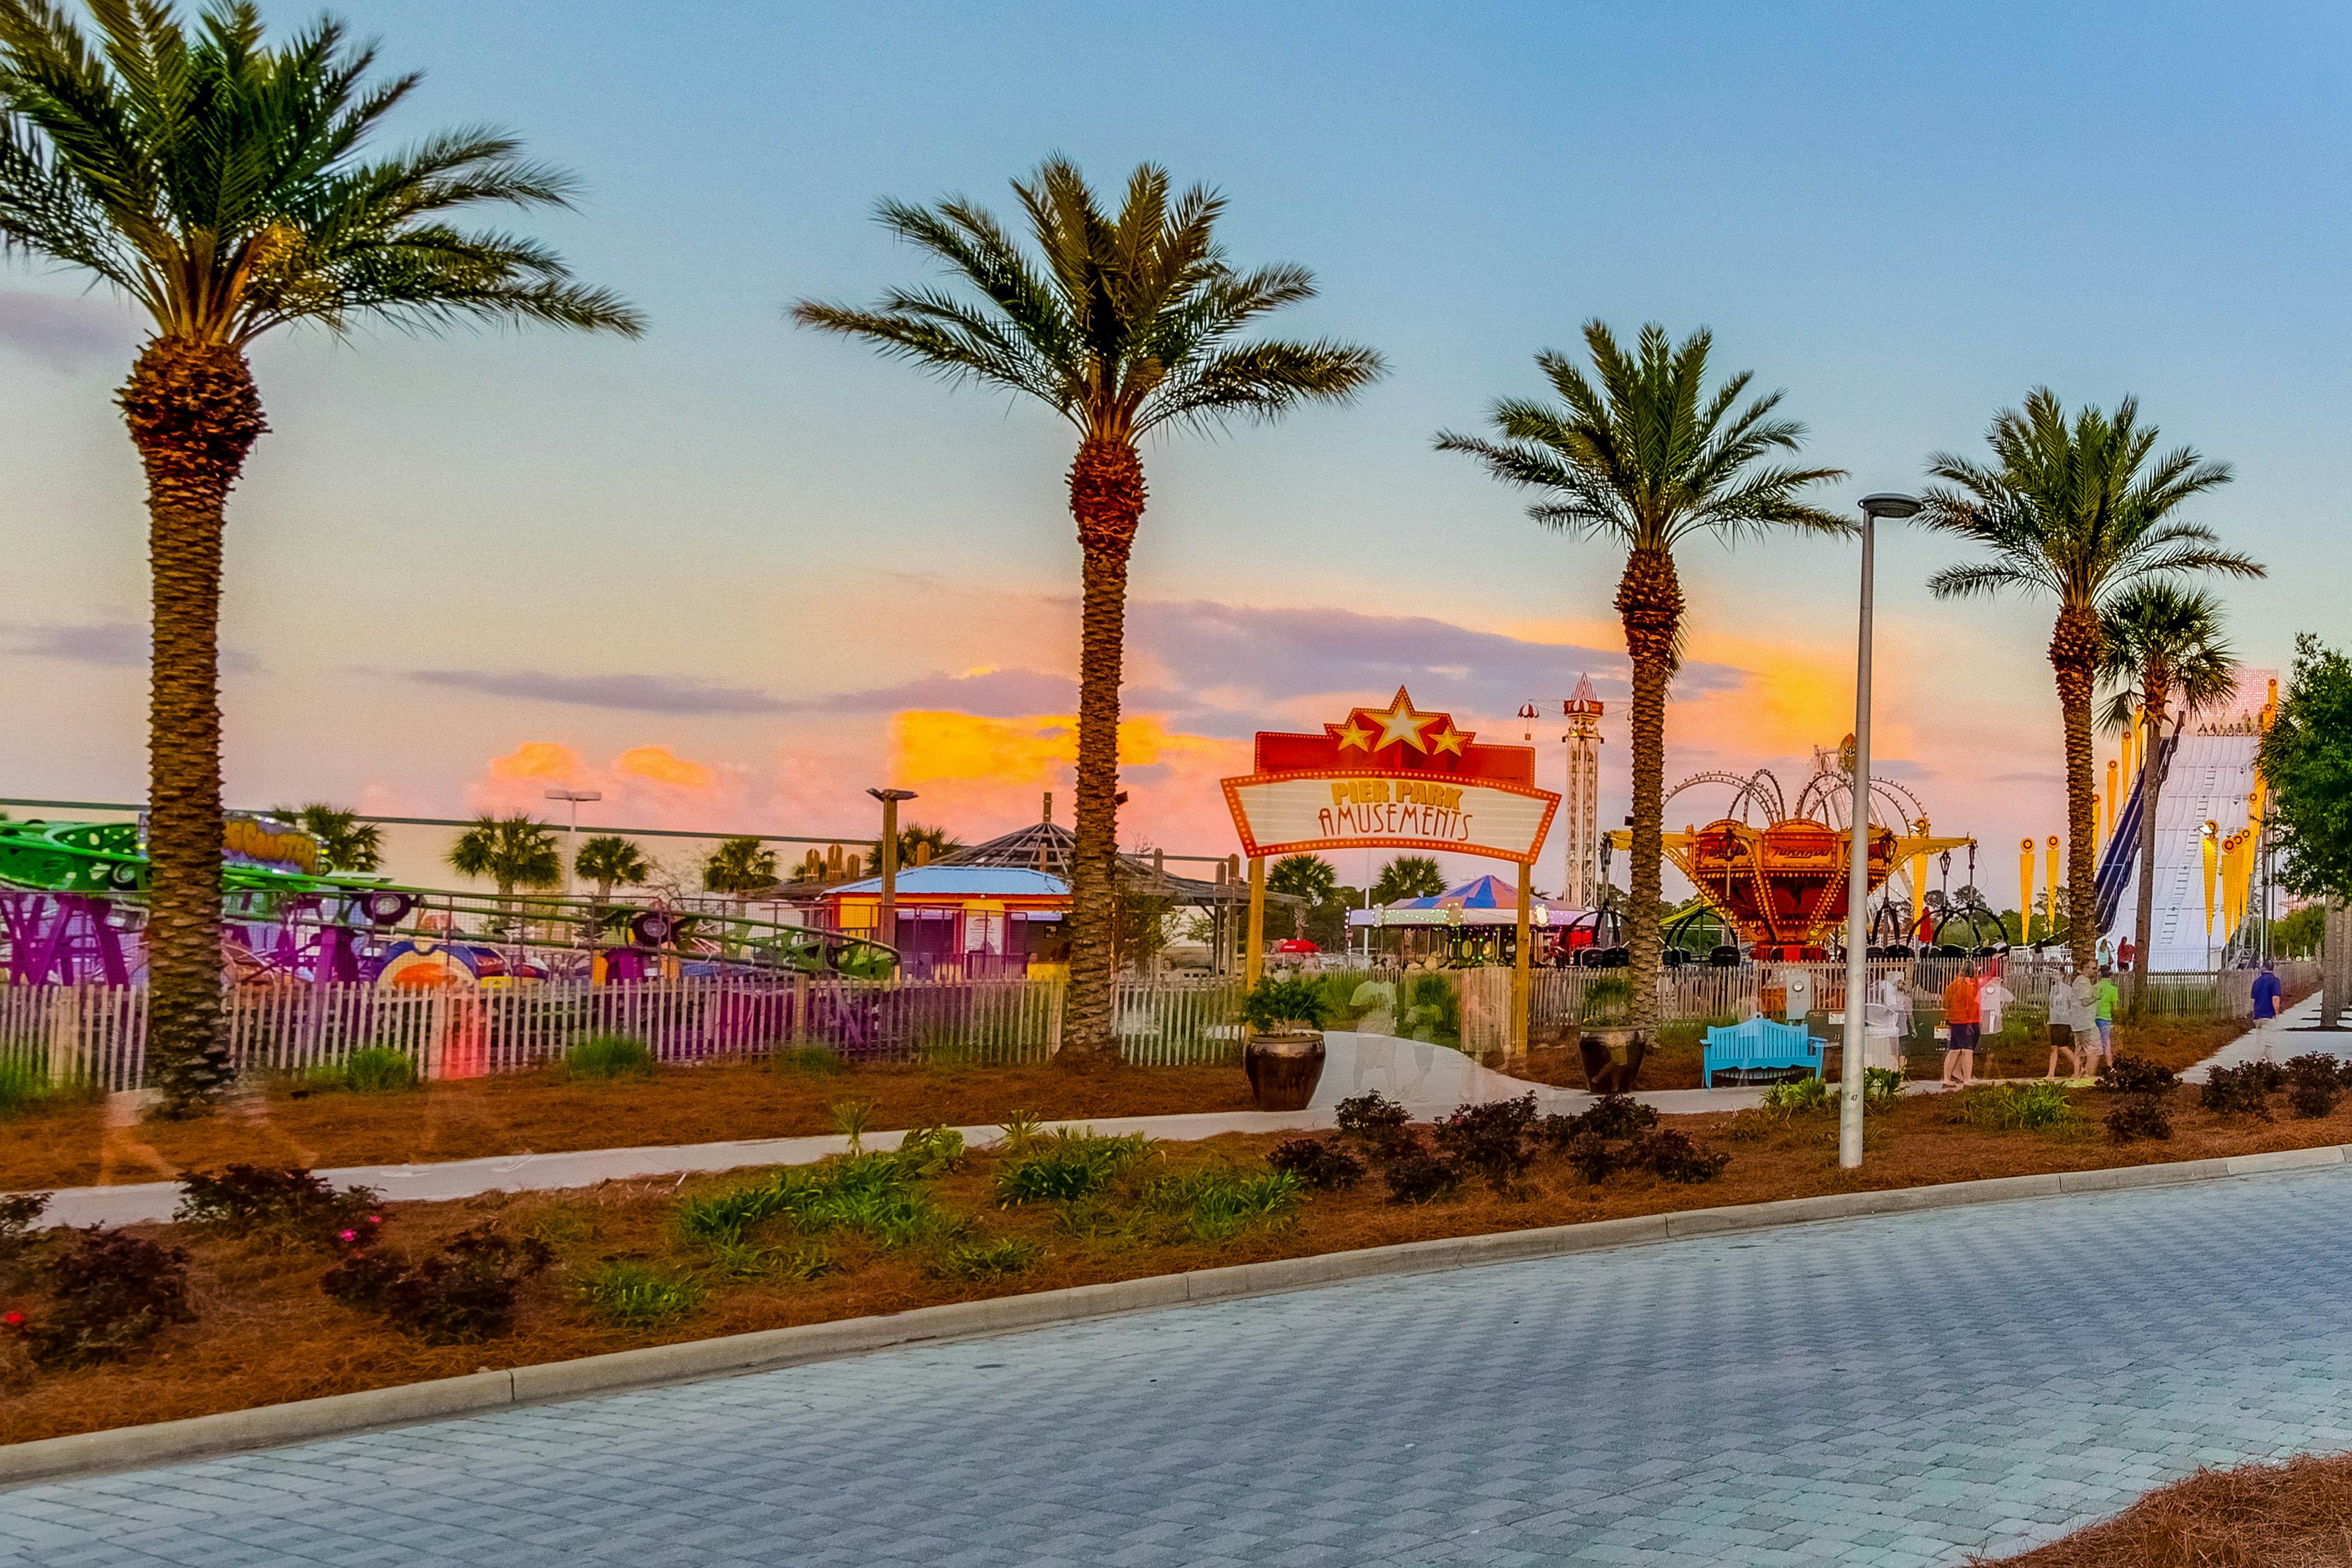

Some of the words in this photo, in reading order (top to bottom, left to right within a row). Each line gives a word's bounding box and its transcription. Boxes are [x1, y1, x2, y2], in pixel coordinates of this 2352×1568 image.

[1331, 780, 1390, 805] PIER
[1396, 781, 1463, 810] PARK
[1318, 803, 1473, 841] AMUSEMENTS
[1771, 846, 1832, 859] TORNADO
